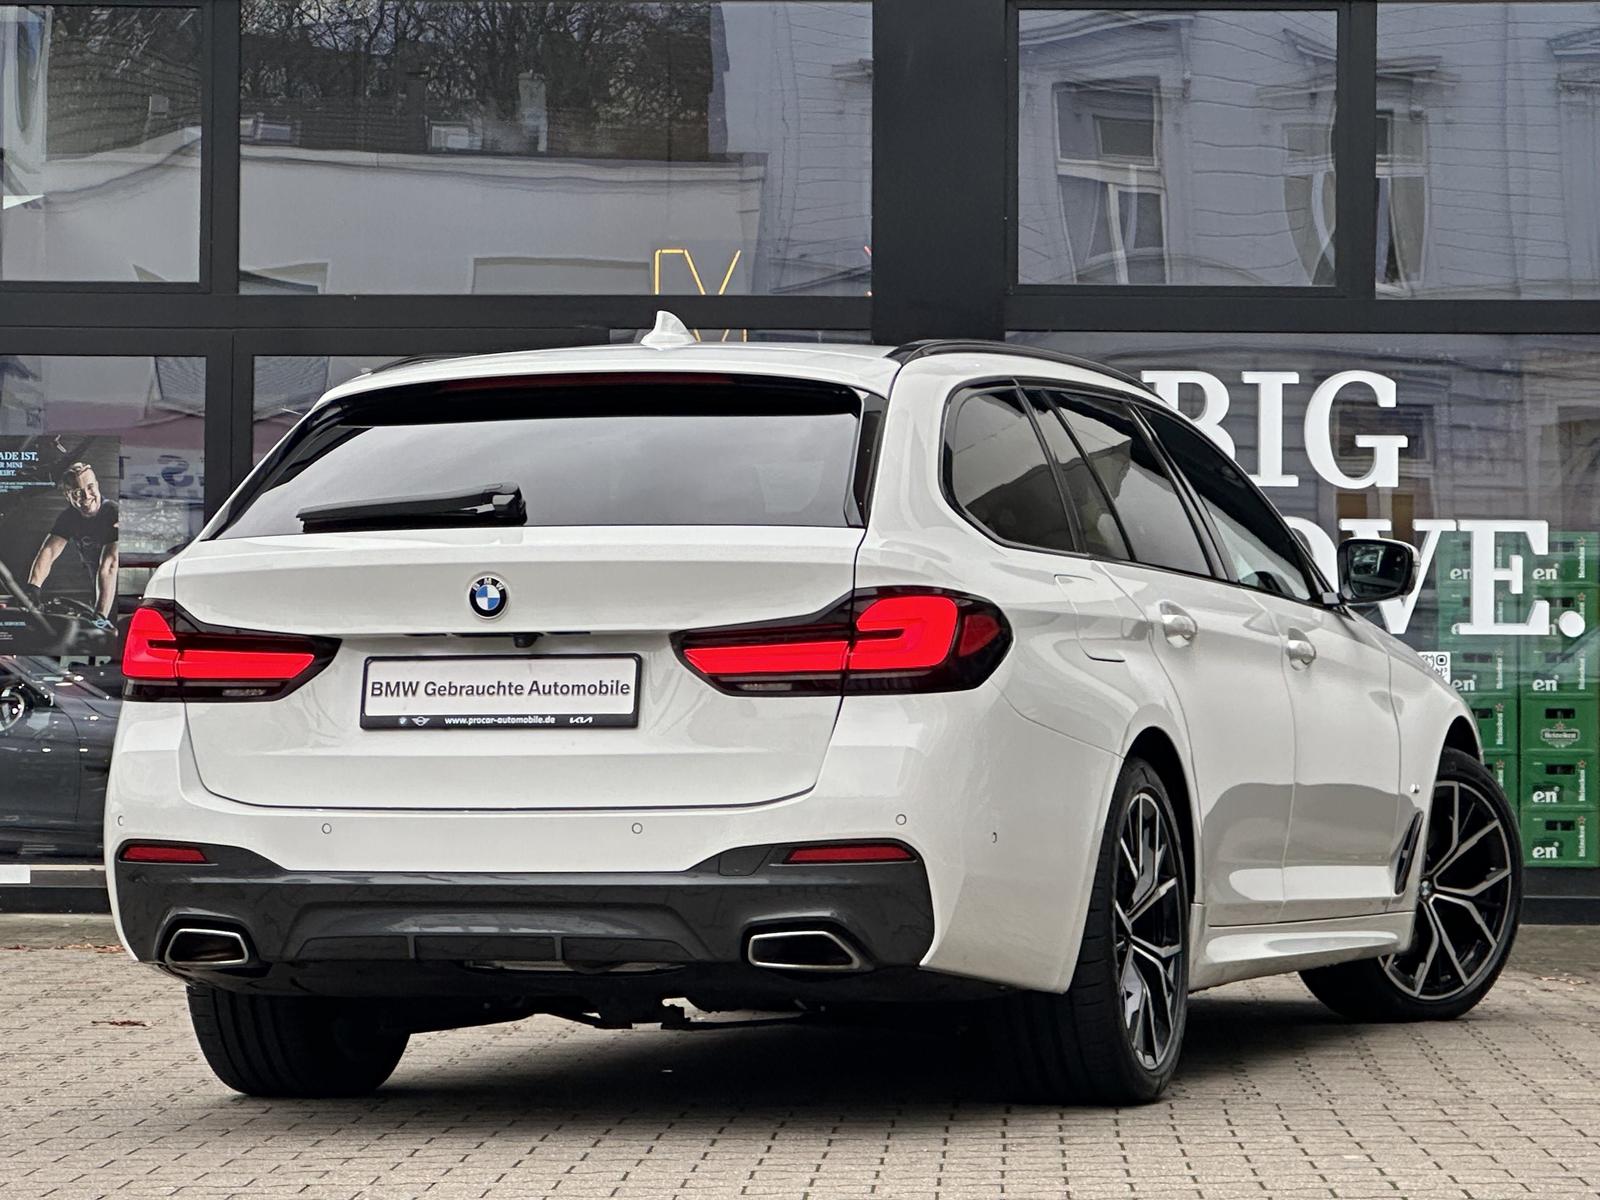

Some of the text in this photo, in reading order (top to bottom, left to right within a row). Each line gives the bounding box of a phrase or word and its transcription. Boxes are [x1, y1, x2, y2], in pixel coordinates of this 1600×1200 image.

[1140, 370, 1409, 489] BIG
[370, 680, 631, 697] BMW Gebrauchte Automobile
[444, 716, 556, 726] www.procar-automobile.de
